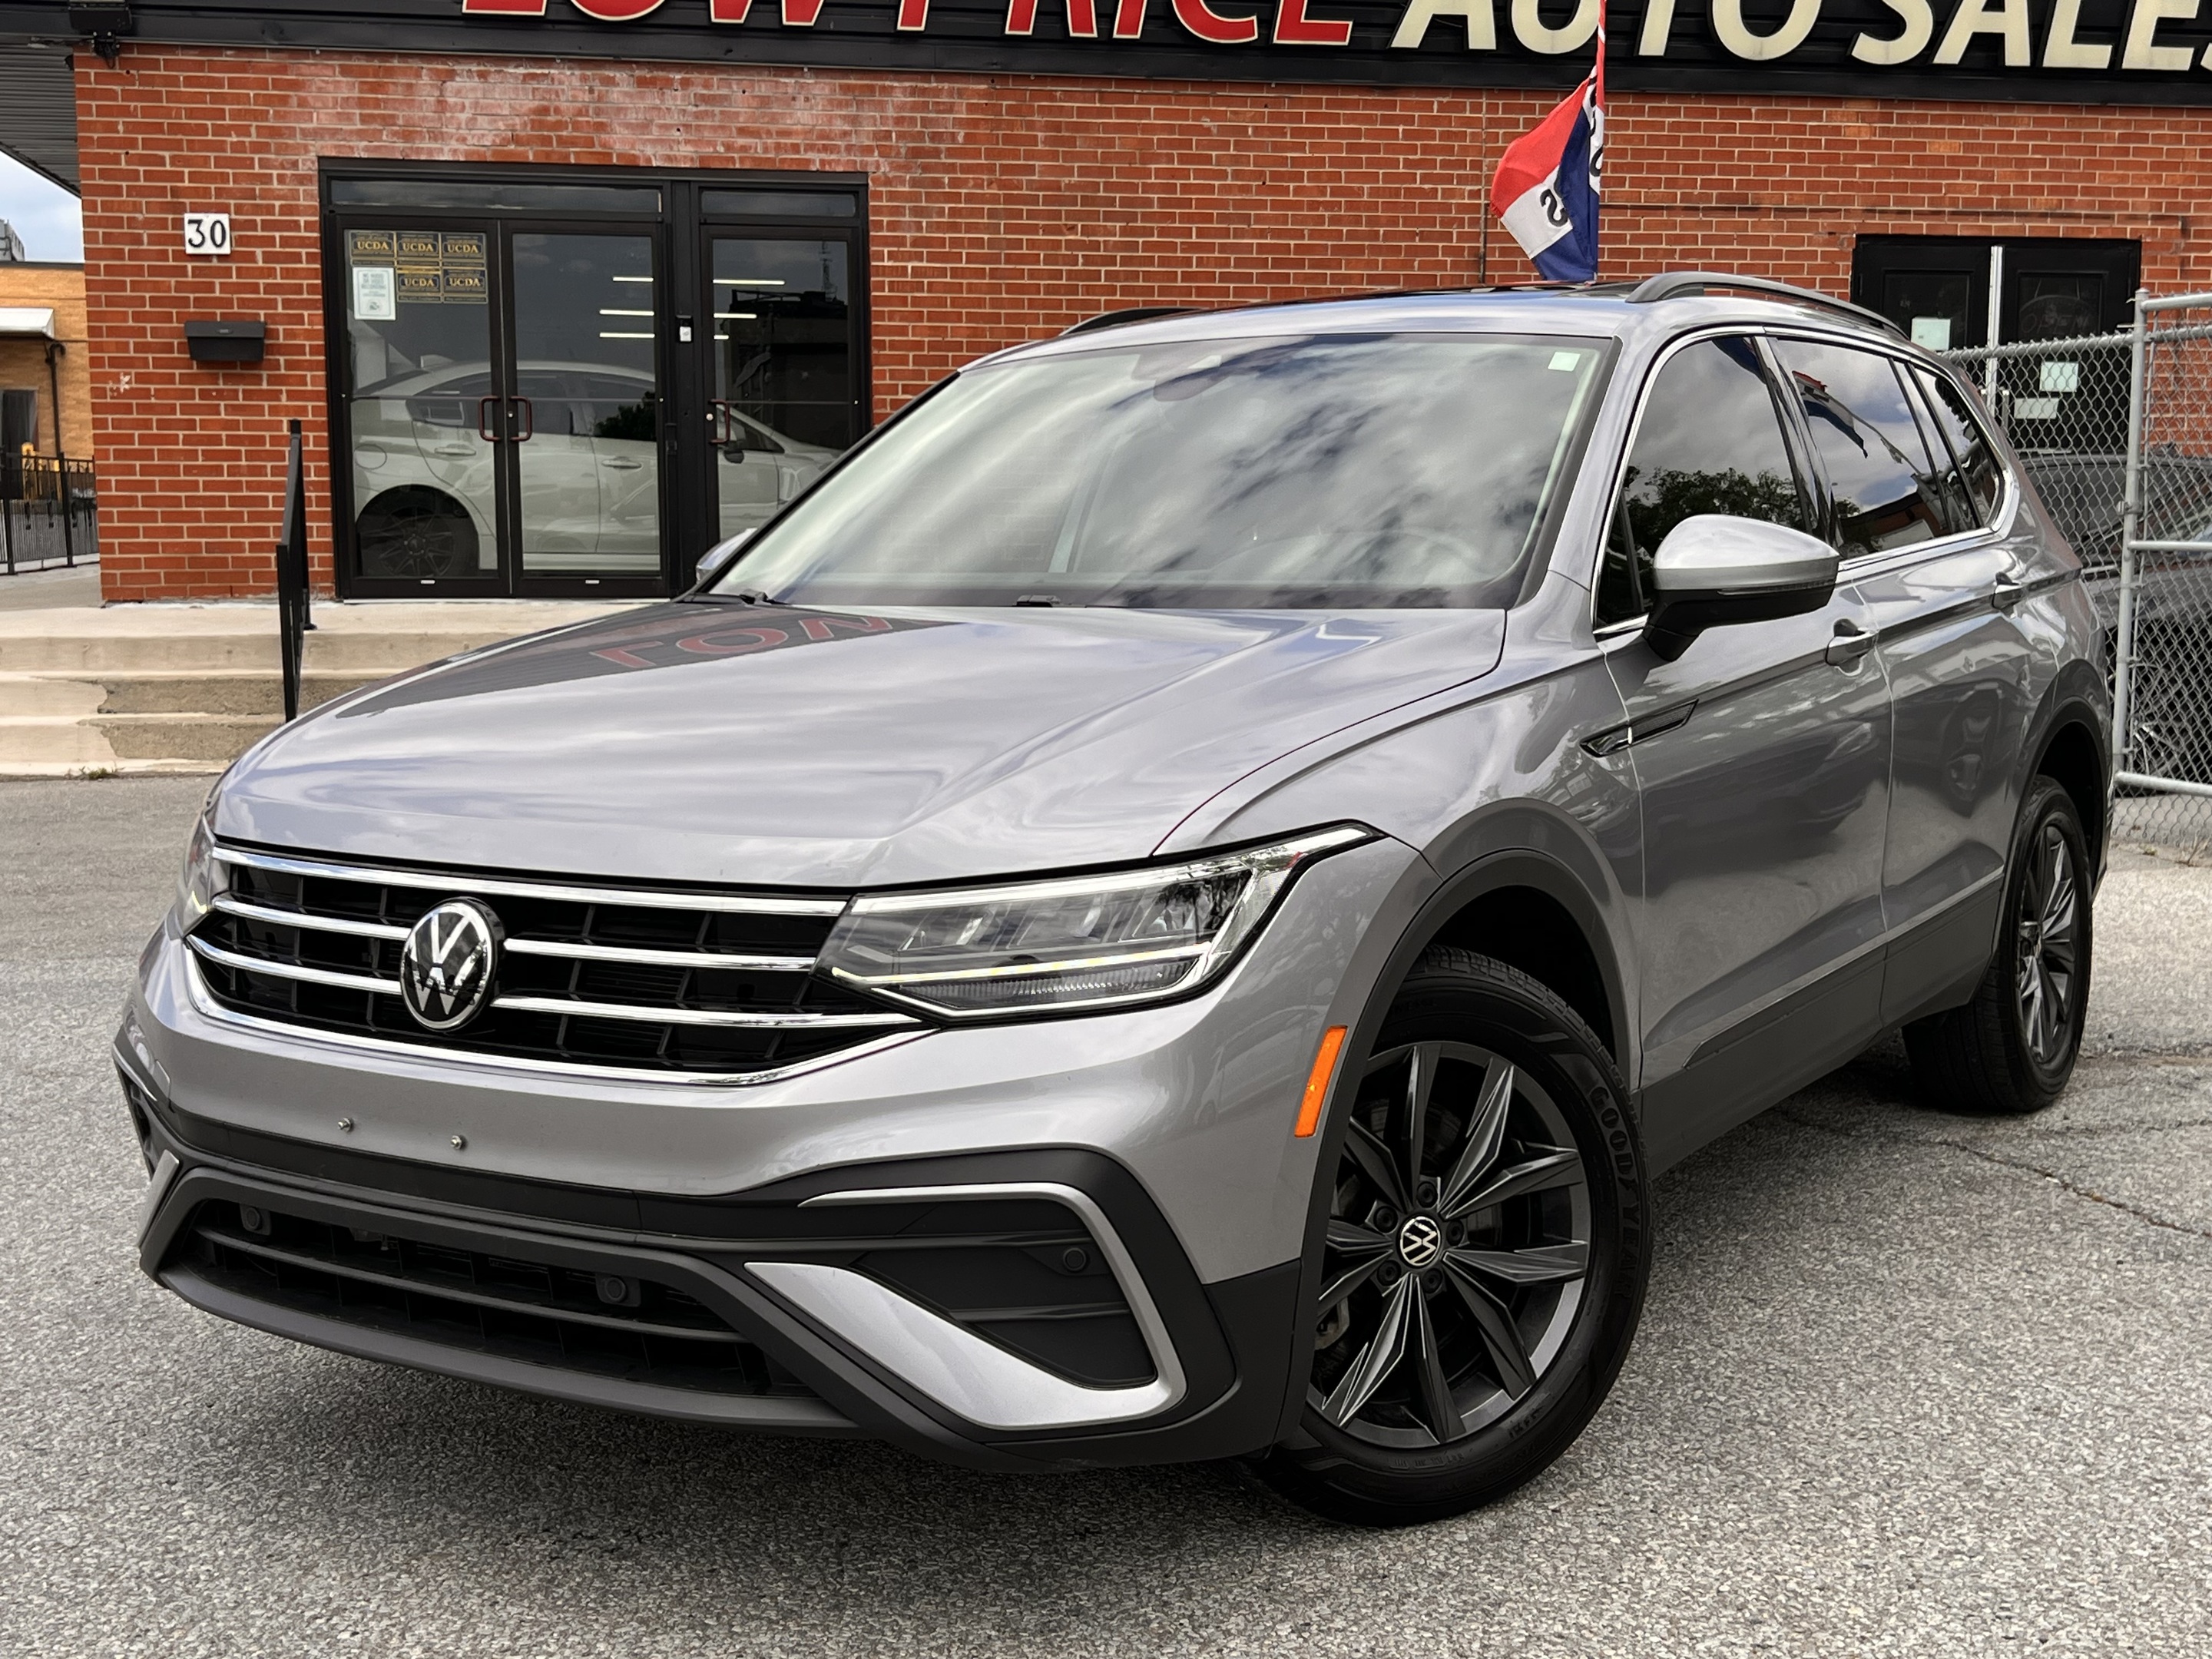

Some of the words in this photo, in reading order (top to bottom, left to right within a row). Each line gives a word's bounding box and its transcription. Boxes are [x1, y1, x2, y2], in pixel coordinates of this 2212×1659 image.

[1850, 0, 2212, 71] SALE
[187, 219, 226, 248] 30
[357, 240, 389, 250] UCDA
[402, 243, 434, 252] UCDA
[447, 244, 478, 253] UCDA
[405, 277, 435, 287] UCDA
[449, 277, 481, 287] UCDA
